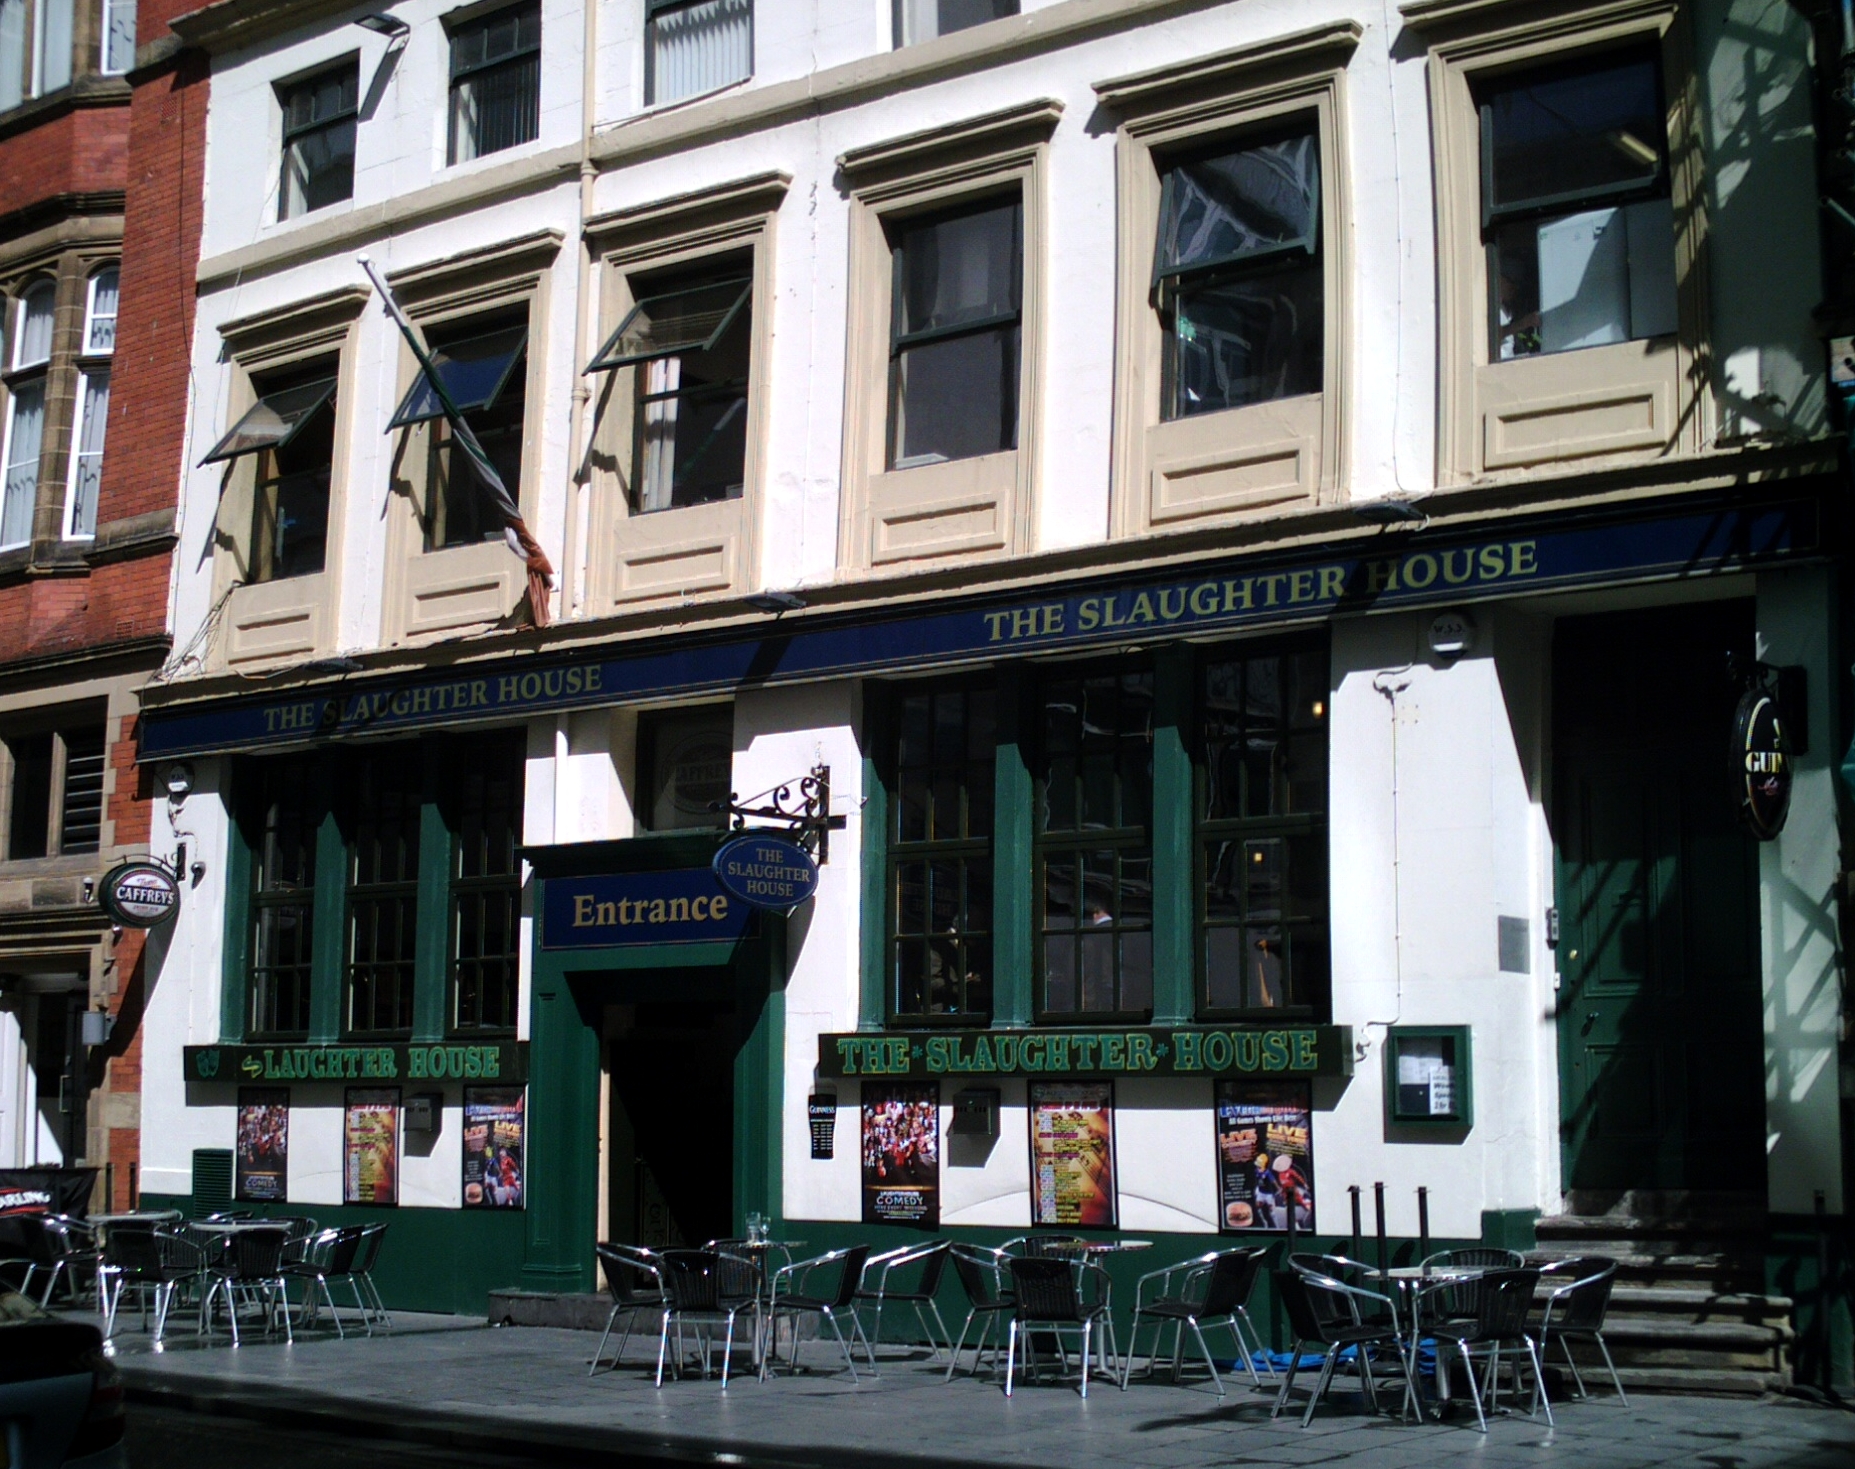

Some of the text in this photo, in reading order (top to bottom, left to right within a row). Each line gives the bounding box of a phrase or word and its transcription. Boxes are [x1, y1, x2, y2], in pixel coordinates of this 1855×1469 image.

[983, 539, 1538, 642] THE SLAUGHTER HOUSE
[263, 664, 603, 732] THE SLAUGHTER HOUSE
[755, 847, 784, 864] THE
[727, 861, 811, 883] SLAUGHTER
[746, 880, 794, 897] HOUSE
[572, 893, 729, 927] Entrance
[407, 1046, 500, 1078] HOUSE
[837, 1030, 1318, 1074] THE SLAUGHTER HOUSE
[1267, 1123, 1307, 1137] LIVE
[876, 1196, 923, 1205] COMEDY
